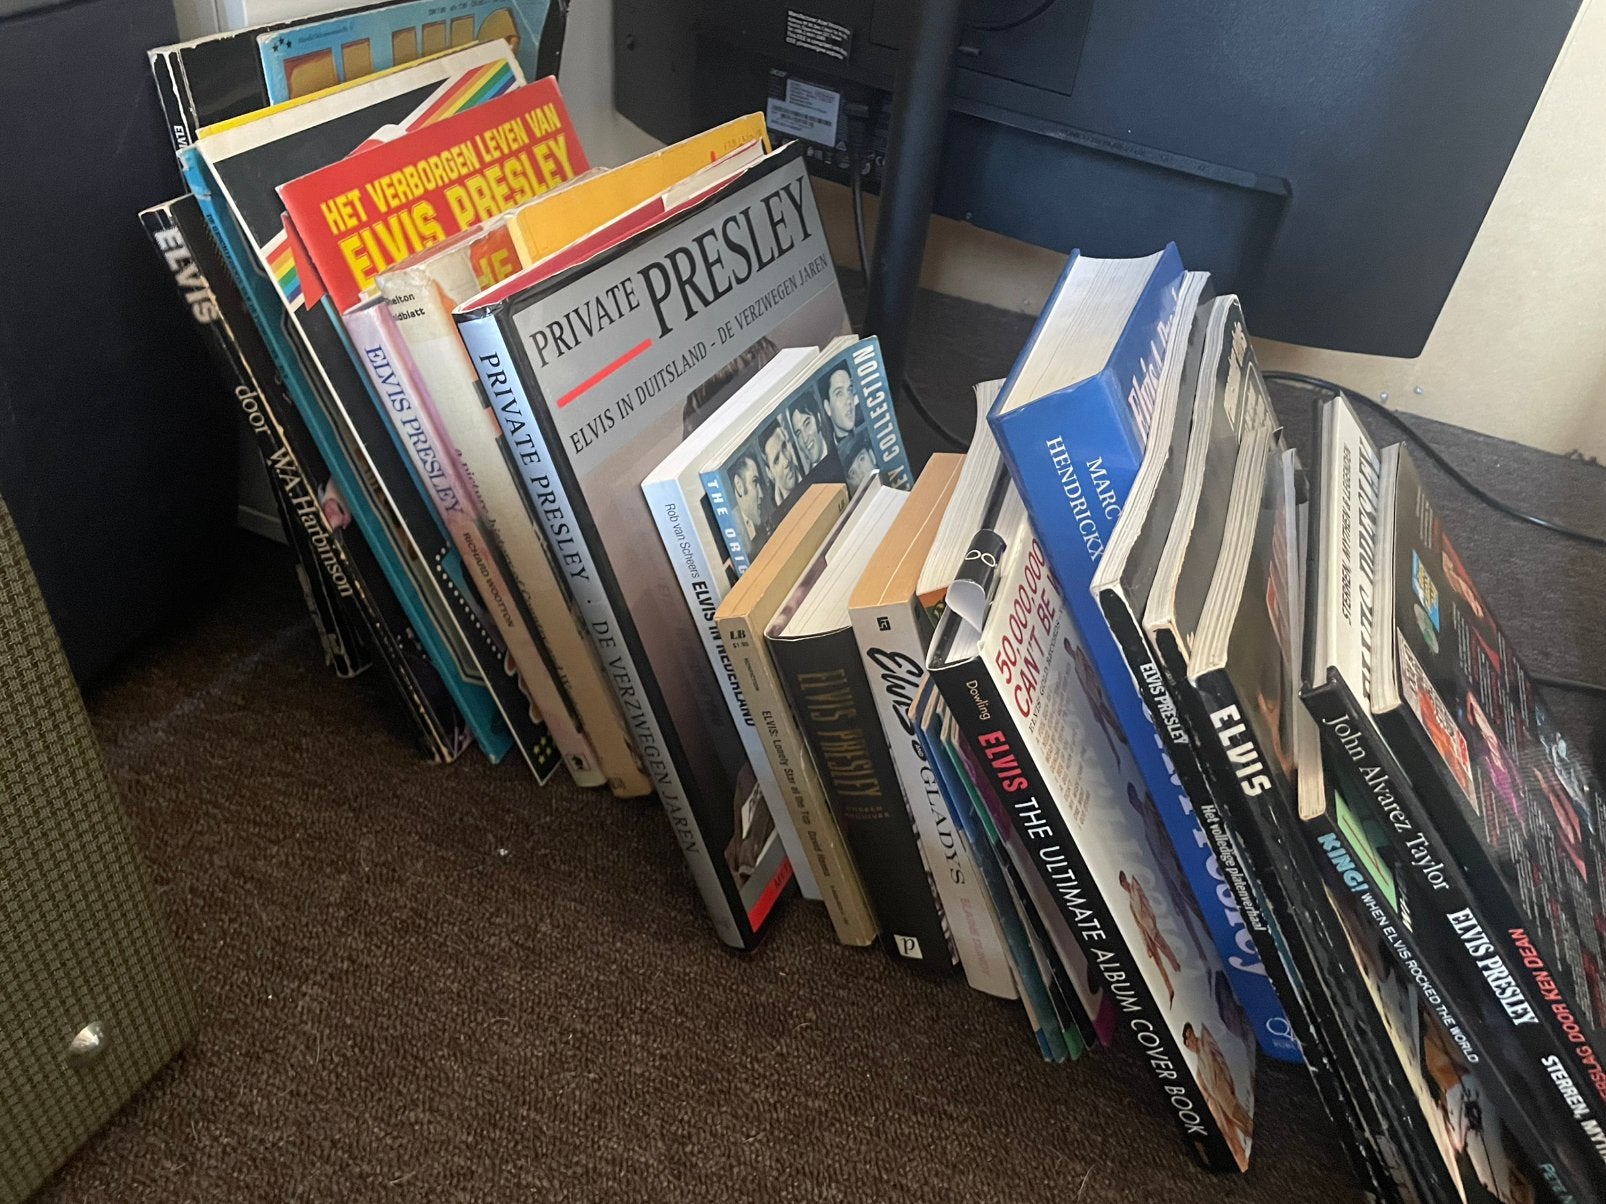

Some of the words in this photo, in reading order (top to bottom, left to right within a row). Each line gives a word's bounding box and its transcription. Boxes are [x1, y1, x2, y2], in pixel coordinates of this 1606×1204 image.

[319, 194, 368, 236] HET
[365, 148, 475, 213] VERBORGEN
[475, 121, 525, 163] LEVEN
[522, 102, 563, 142] VAN
[337, 199, 446, 290] ELVIS
[445, 134, 578, 234] PRESLEY
[154, 226, 219, 324] ELVIS
[636, 174, 813, 340] PRESLEY
[386, 292, 416, 306] elton
[529, 275, 641, 368] PRIVATE
[569, 407, 616, 456] ELVIS
[619, 396, 636, 419] IN
[636, 339, 708, 409] DUITSLAND
[717, 316, 735, 343] DE
[734, 278, 799, 331] VERZWEGEN
[798, 251, 829, 287] JAREN
[234, 384, 271, 436] door
[366, 344, 408, 417] ELVIS
[402, 411, 464, 516] PRESLEY
[852, 344, 901, 464] COLLECTION
[664, 502, 677, 523] Rob
[706, 479, 729, 516] THE
[1045, 434, 1105, 562] HENDRICKX
[1086, 456, 1122, 521] MARC
[463, 531, 490, 576] RICHARD
[673, 521, 686, 542] van
[679, 541, 700, 579] Scheers
[479, 351, 541, 466] PRIVATE
[530, 474, 590, 581] PRESLEY
[592, 620, 617, 650] DE
[608, 655, 673, 786] VERZWEGEN
[661, 787, 699, 854] JAREN
[691, 580, 716, 623] ELVIS
[729, 629, 746, 640] LB
[995, 537, 1046, 685] 50,000,000
[1014, 625, 1045, 718] CAN'T
[1036, 587, 1056, 637] BE
[797, 668, 857, 722] ELVIS
[965, 679, 992, 721] Dowling
[1139, 662, 1162, 700] ELVIS
[1155, 695, 1190, 745] PRESLEY
[761, 709, 779, 738] ELVIS:
[773, 738, 789, 769] Lonely
[784, 767, 796, 786] Star
[816, 728, 883, 797] PRESLEY
[866, 647, 925, 736] Elvis
[919, 765, 966, 886] GLADYS
[978, 730, 1029, 793] ELVIS
[1209, 703, 1273, 798] ELVIS
[1014, 796, 1053, 841] THE
[1037, 845, 1106, 944] ULTIMATE
[1201, 803, 1213, 825] Het
[1207, 823, 1236, 868] volledige
[1225, 865, 1268, 932] platenverhaal
[1316, 831, 1368, 893] KING!
[1360, 892, 1389, 926] WHEN
[1383, 925, 1412, 960] ELVIS
[1404, 959, 1441, 1004] ROCKED
[1435, 1003, 1456, 1027] THE
[1449, 1025, 1480, 1064] WORLD
[1322, 713, 1367, 762] John
[1359, 764, 1413, 833] Alvarez
[1404, 830, 1451, 893] Taylor
[1446, 907, 1491, 962] ELVIS
[1475, 951, 1540, 1027] PRESLEY
[1540, 1053, 1591, 1121] STERREN,
[1508, 927, 1545, 970] DEAN
[1091, 946, 1141, 1015] ALBUM
[1532, 969, 1563, 1002] KEN
[1129, 1017, 1182, 1081] COVER
[1550, 1002, 1586, 1044] DOOR
[1163, 1084, 1208, 1138] BOOK
